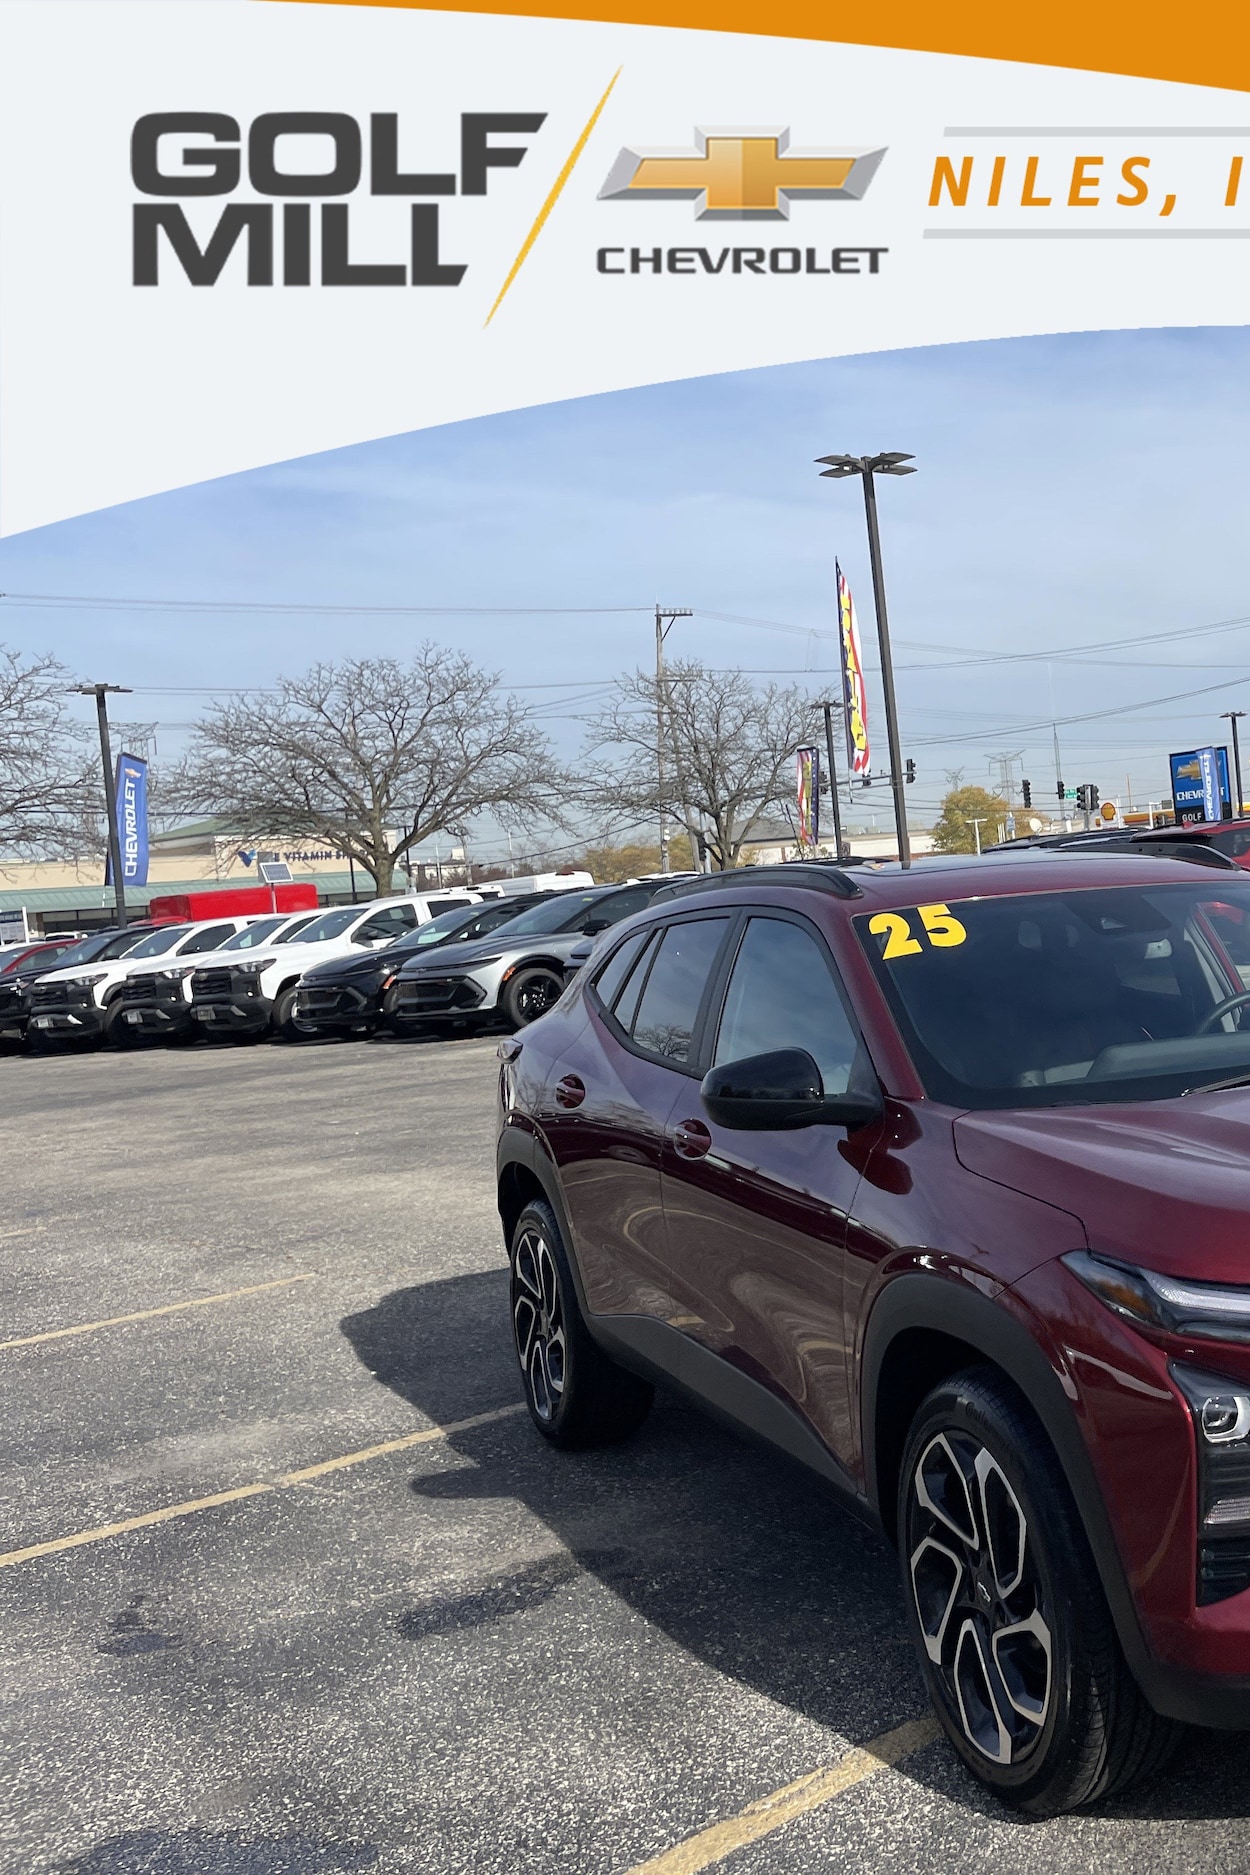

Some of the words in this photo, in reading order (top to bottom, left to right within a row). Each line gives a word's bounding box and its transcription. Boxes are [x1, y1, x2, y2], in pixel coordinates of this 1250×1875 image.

[1176, 786, 1225, 801] CHEVRT
[1182, 812, 1202, 821] GOLF
[124, 777, 138, 877] CHEVROLET
[283, 850, 333, 862] VITAMIN
[868, 903, 967, 960] 25
